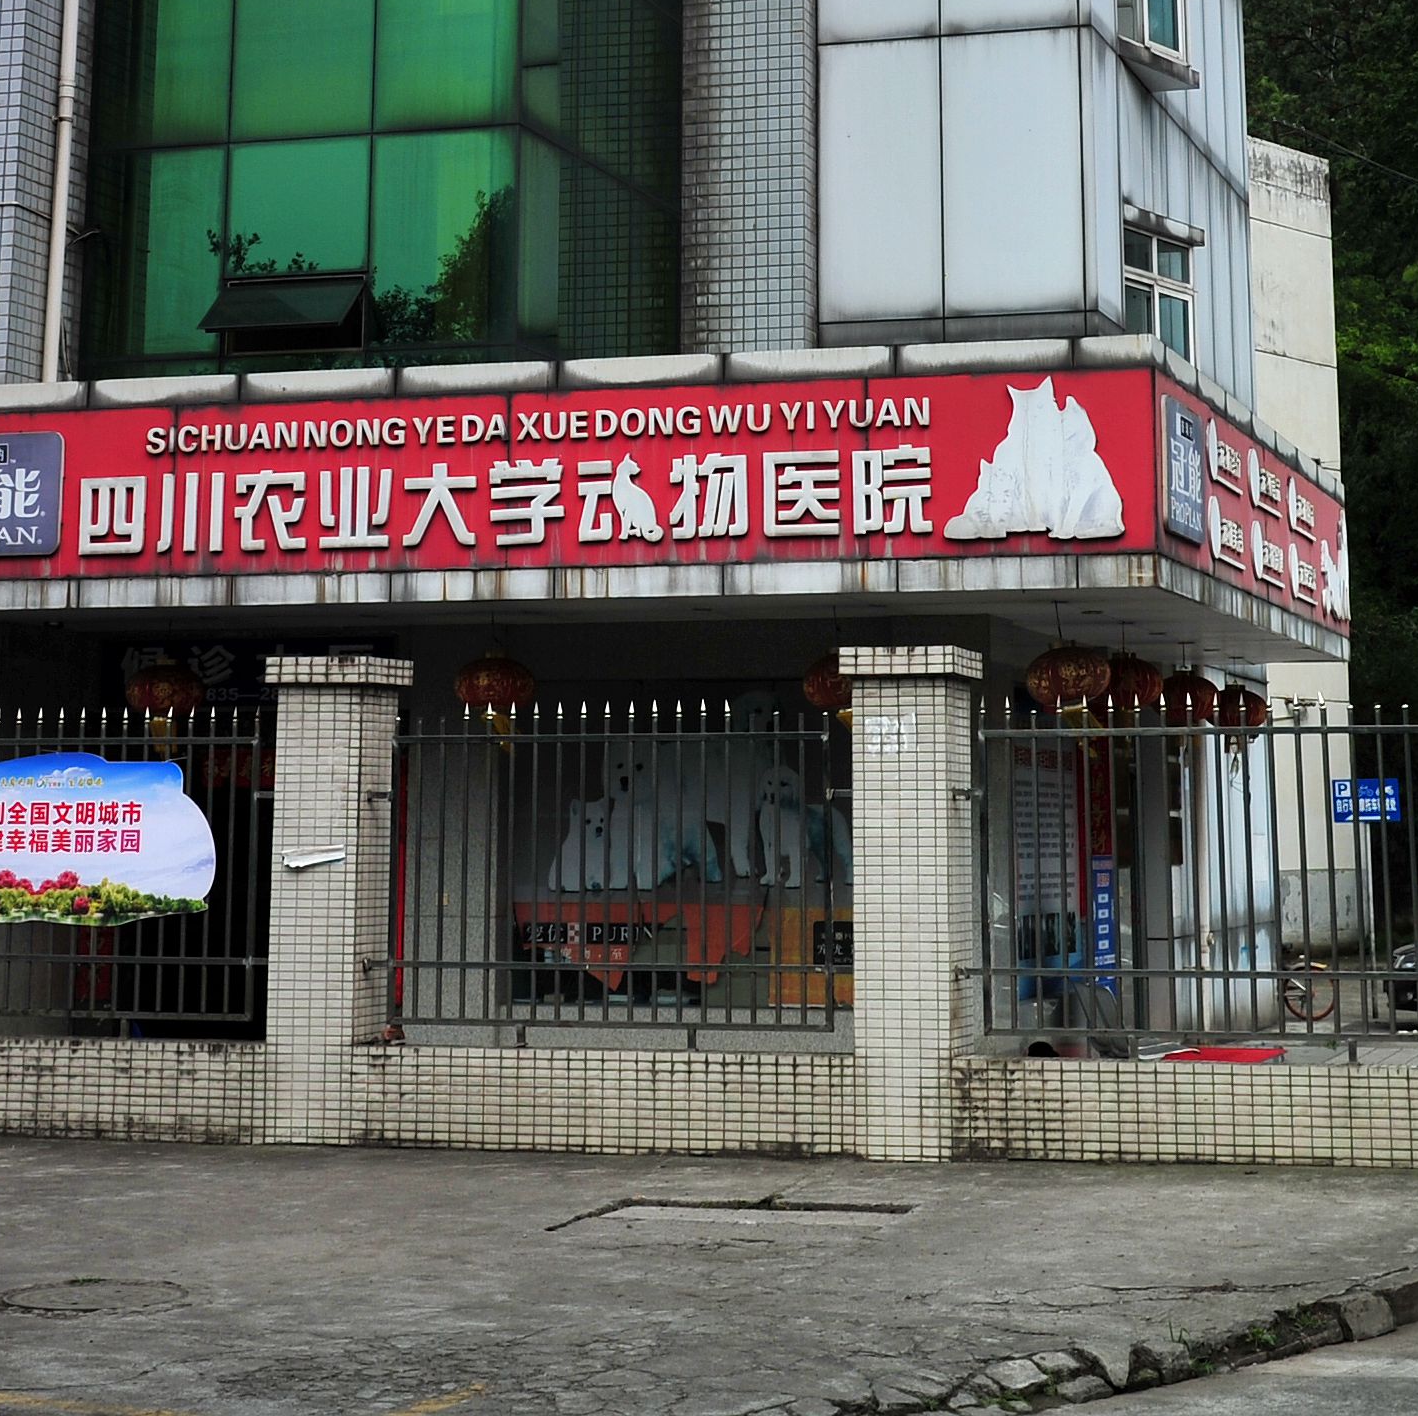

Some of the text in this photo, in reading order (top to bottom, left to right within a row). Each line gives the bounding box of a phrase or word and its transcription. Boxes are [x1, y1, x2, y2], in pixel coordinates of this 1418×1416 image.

[78, 444, 934, 556] 四川农业大学动物医院
[1170, 437, 1203, 504] 冠能
